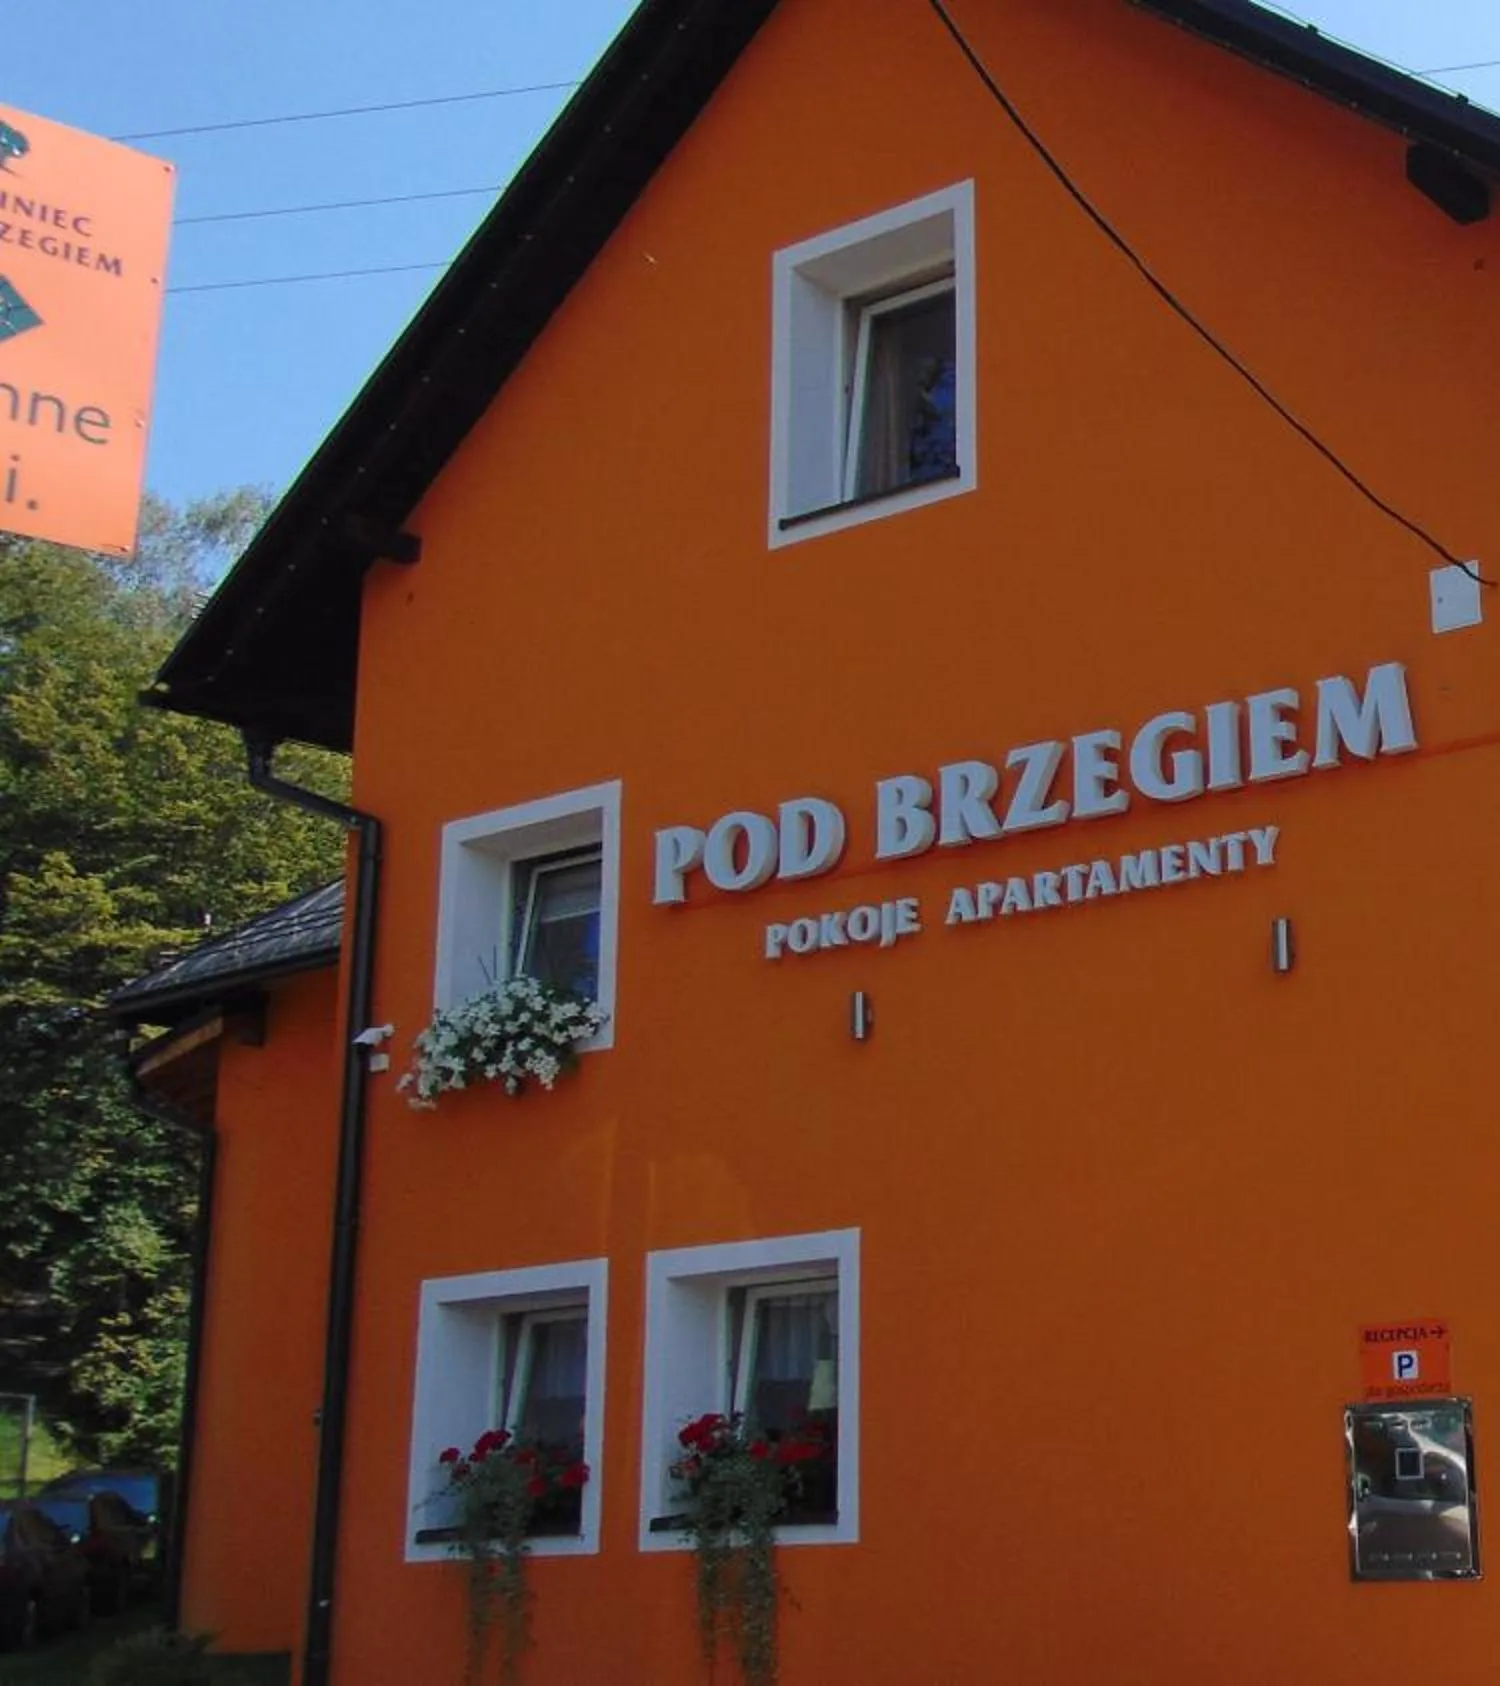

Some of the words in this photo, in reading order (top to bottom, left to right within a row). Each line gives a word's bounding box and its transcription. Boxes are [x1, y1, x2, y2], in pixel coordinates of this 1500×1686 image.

[652, 796, 847, 905] POD
[874, 661, 1418, 861] BRZEGIEM
[764, 897, 922, 958] POKOJE
[944, 824, 1281, 926] APARTAMENTY
[1364, 1327, 1428, 1343] RECEPCJA
[1396, 1353, 1414, 1378] P
